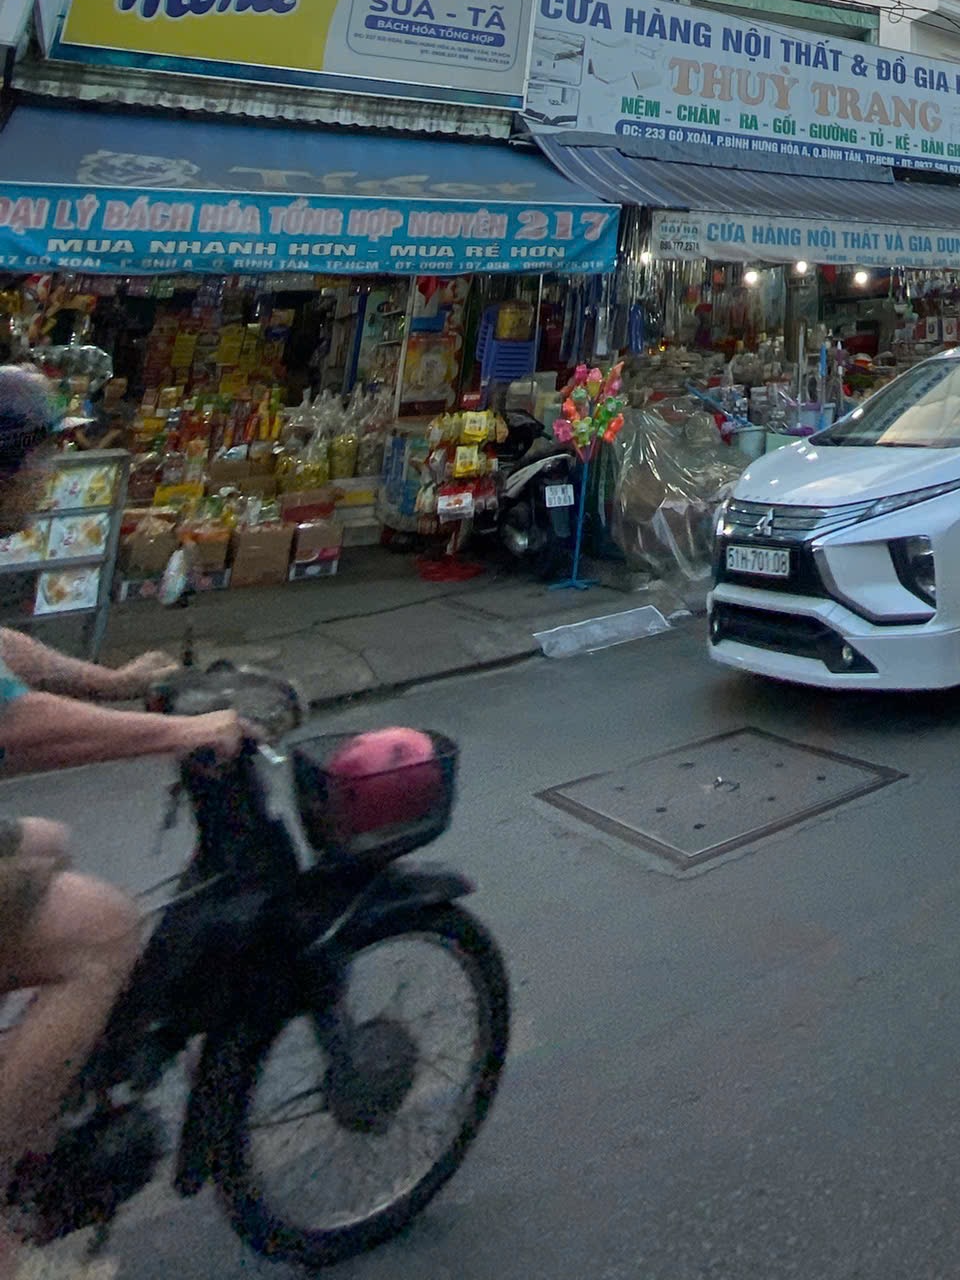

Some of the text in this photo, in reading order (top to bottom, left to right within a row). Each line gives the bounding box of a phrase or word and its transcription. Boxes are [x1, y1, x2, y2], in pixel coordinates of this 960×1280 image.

[377, 19, 409, 33] BÁCH
[411, 21, 436, 37] HÓA
[471, 32, 495, 45] HỢP
[467, 4, 506, 31] TÃ
[624, 7, 712, 48] HÀNG
[722, 26, 771, 62] NỘI
[780, 39, 842, 72] THẤT
[851, 54, 868, 77] &
[876, 55, 906, 84] ĐỒ
[914, 66, 950, 93] GIA
[811, 80, 943, 133] TRANG
[620, 95, 661, 119] NỆM
[676, 104, 720, 125] CHĂN
[739, 113, 758, 130] RA
[773, 113, 796, 135] GỐI
[809, 123, 857, 144] GIƯỜNG
[869, 128, 884, 147] TỦ
[895, 133, 910, 154] KỆ
[921, 137, 944, 155] BÀN
[645, 127, 666, 139] 233
[668, 128, 683, 141] GÒ
[53, 194, 99, 231] LÝ
[102, 195, 195, 232] BÁCH
[347, 207, 403, 242] HỢP
[407, 208, 508, 239] NGUYÊN
[514, 210, 610, 241] 217
[48, 238, 134, 253] MUA
[149, 240, 277, 256] NHANH
[288, 242, 357, 256] HƠN
[390, 244, 454, 257] MUA
[510, 245, 565, 257] HƠN
[752, 223, 801, 246] HÀNG
[807, 225, 836, 252] NỘI
[842, 226, 881, 250] THẤT
[884, 228, 905, 251] VÀ
[908, 235, 932, 254] GIA
